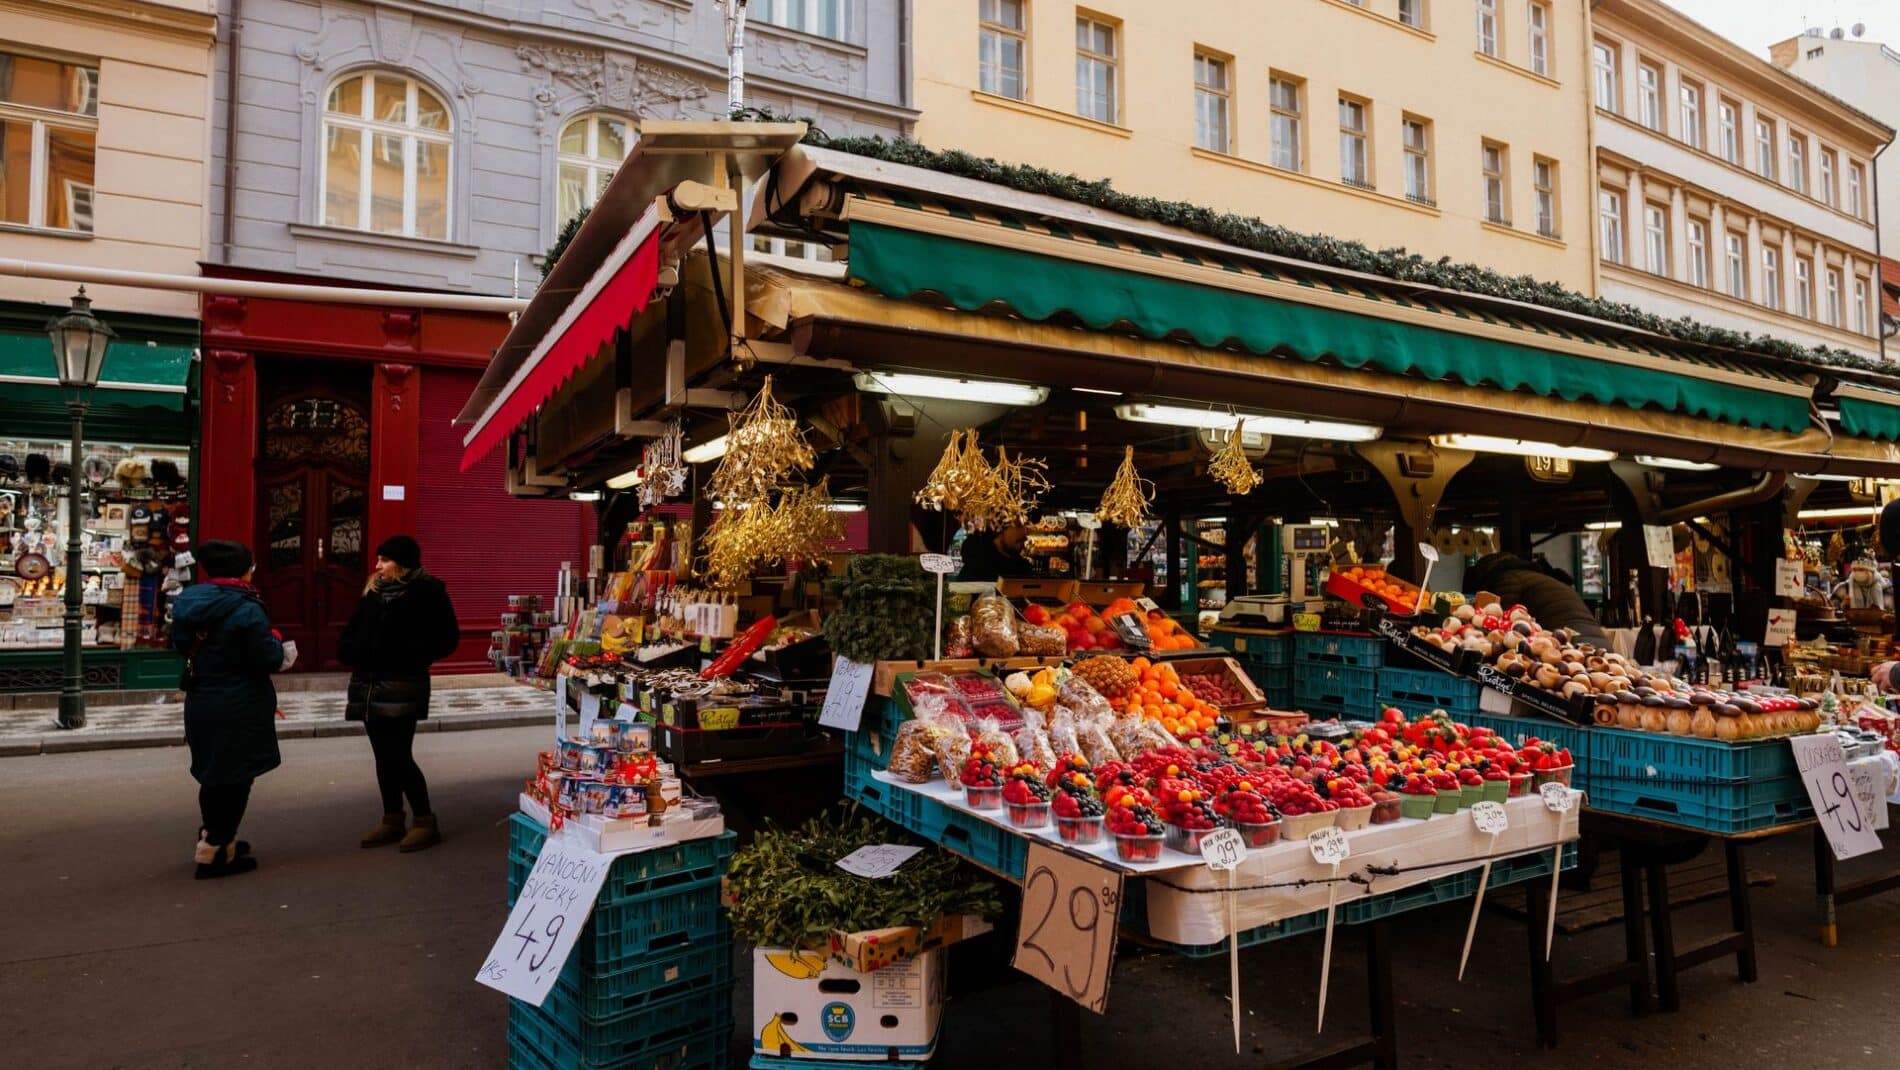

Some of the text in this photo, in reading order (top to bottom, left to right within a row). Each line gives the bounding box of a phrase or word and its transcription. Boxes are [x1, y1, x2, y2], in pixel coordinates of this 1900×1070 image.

[536, 853, 607, 884] VÁNOČNÍ
[521, 876, 580, 912] SVÍČKY
[1022, 865, 1100, 1000] 29
[828, 1013, 849, 1023] SCB
